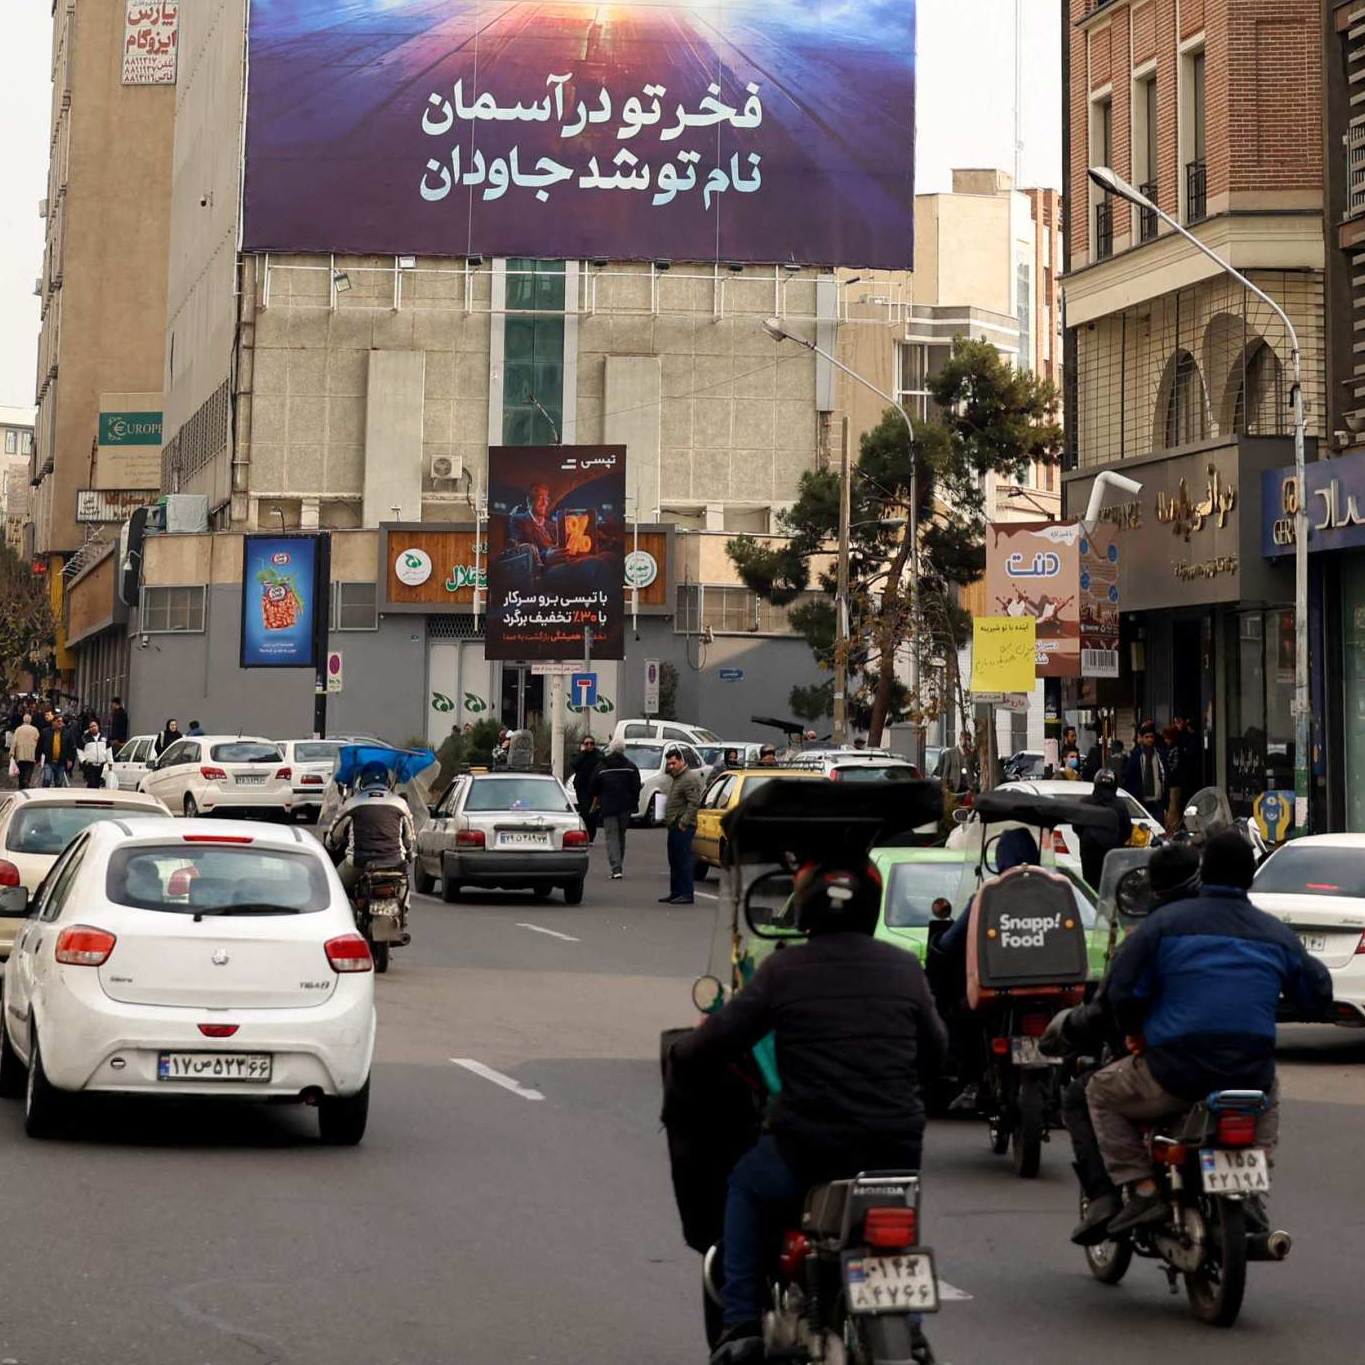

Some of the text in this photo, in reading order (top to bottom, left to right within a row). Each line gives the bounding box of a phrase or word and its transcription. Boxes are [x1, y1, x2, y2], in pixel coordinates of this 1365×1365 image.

[128, 0, 177, 26] پارس
[126, 28, 177, 55] ایزوگام
[155, 71, 172, 82] فاکس
[422, 73, 763, 138] فخر تو در آسمان
[419, 144, 762, 210] نام تو شد جاودان
[581, 455, 616, 471] تپسی
[1007, 552, 1059, 577] دنت
[503, 591, 608, 608] با تپسی برو سرکار
[502, 609, 529, 627] برگرد
[529, 611, 572, 627] تخفیف
[598, 611, 608, 626] با
[999, 913, 1061, 933] Snapp!
[1001, 930, 1044, 948] Food
[853, 1186, 905, 1195] HONDA
